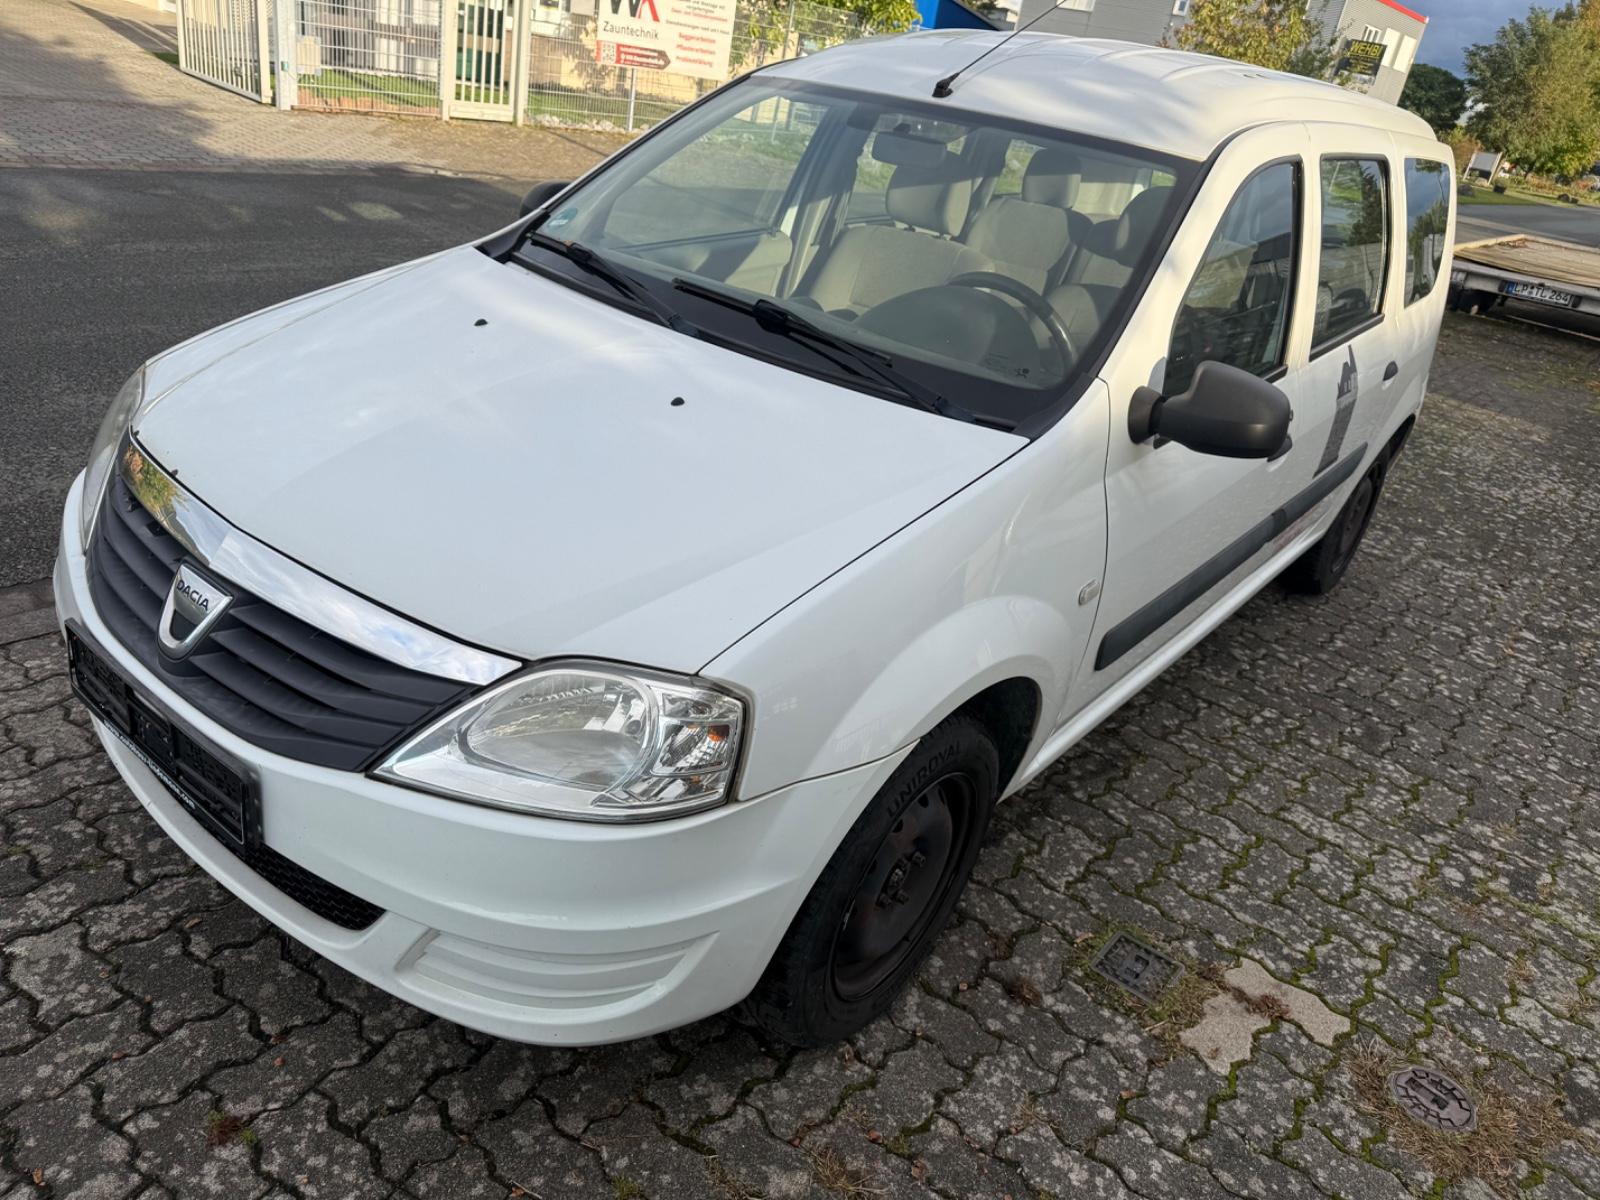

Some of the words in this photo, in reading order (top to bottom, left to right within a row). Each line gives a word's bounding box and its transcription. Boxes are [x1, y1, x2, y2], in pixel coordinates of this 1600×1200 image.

[603, 21, 659, 40] Zauntechnik
[176, 579, 210, 611] DACIA
[887, 740, 964, 818] UNIROYAL
